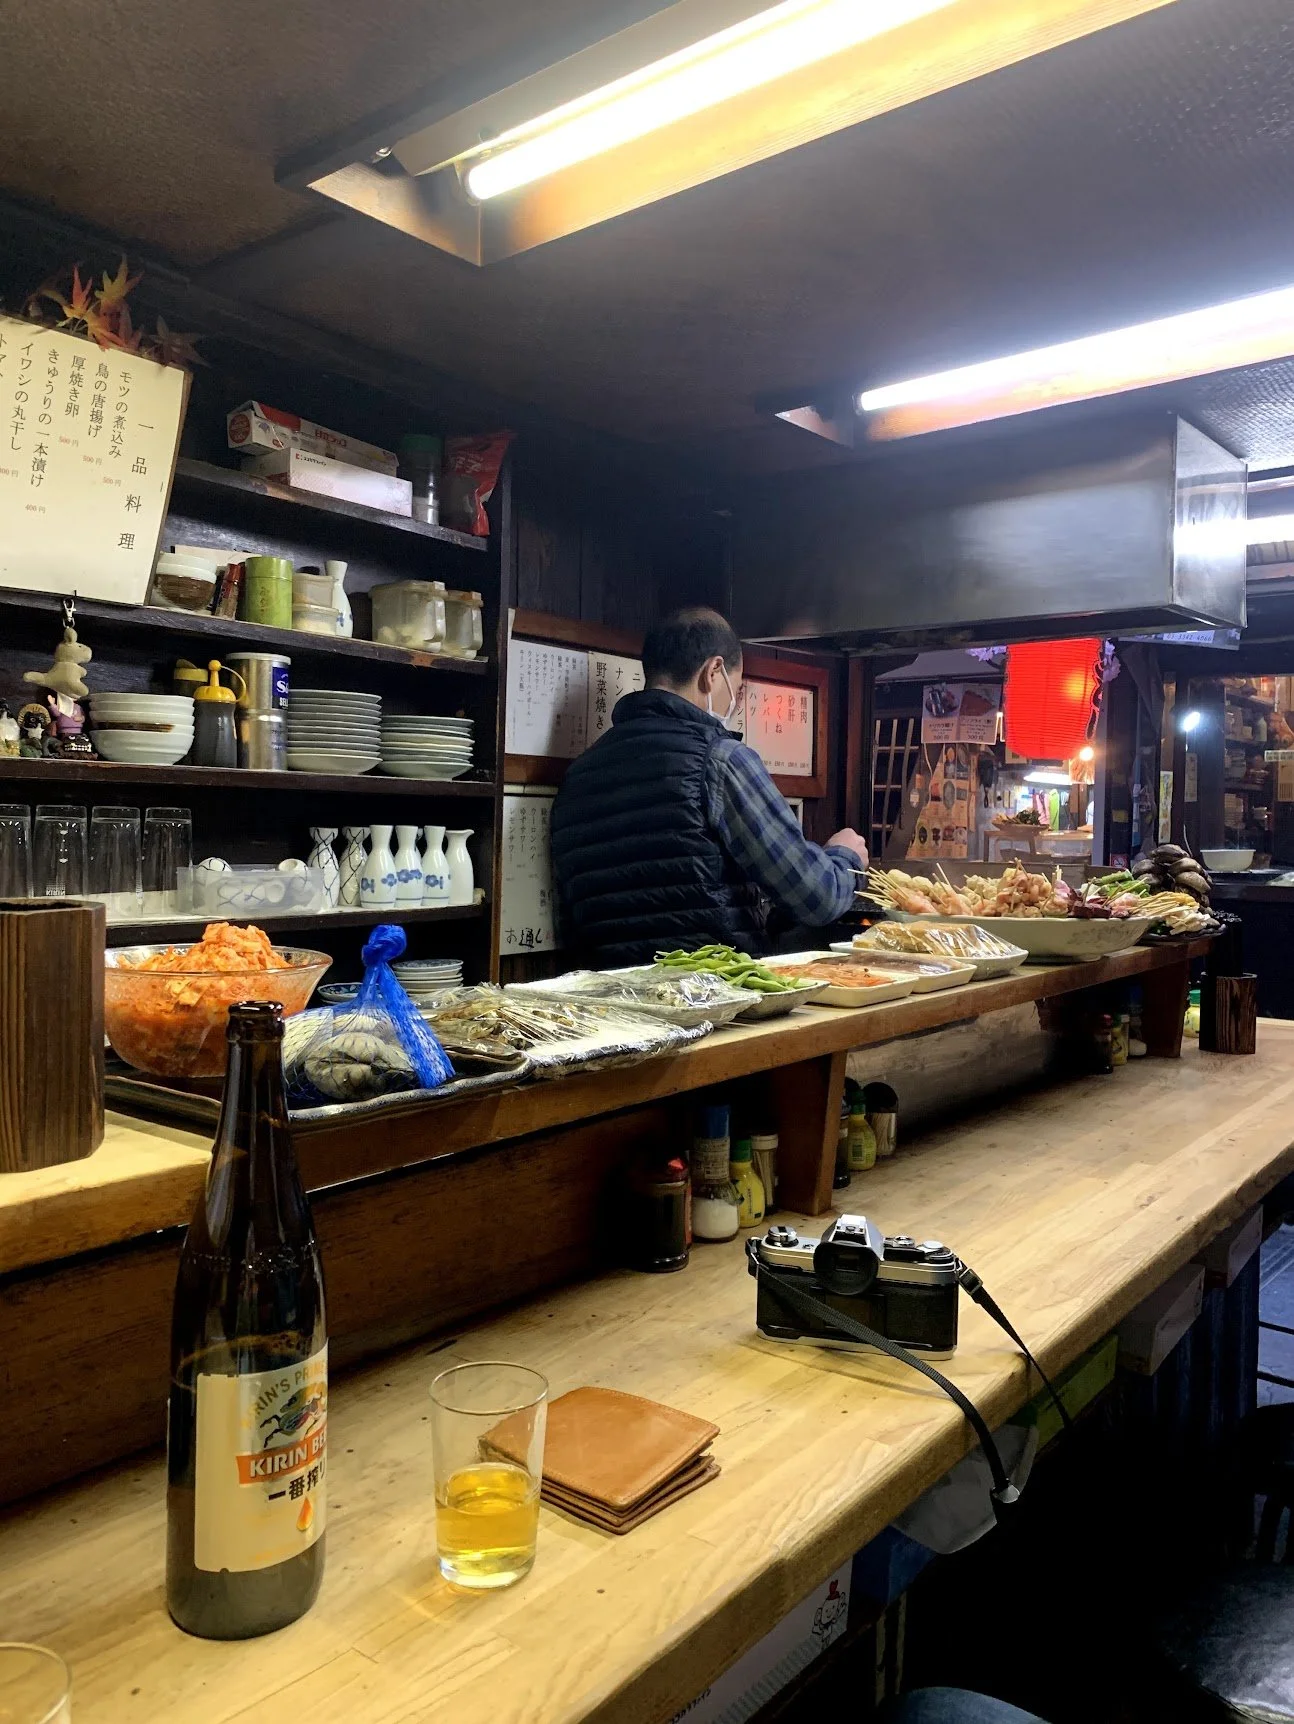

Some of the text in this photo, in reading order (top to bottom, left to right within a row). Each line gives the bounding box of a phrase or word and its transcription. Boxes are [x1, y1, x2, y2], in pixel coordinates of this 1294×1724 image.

[10, 343, 34, 450] イワシの丸干し
[30, 349, 59, 487] きゅうりの一本漬け
[64, 355, 86, 418] 厚焼き卵
[88, 363, 109, 438] 鳥の唐揚げ
[109, 371, 132, 458] モツの煮込み
[596, 661, 607, 729] 野菜焼き
[749, 693, 757, 716] ハツ
[775, 695, 783, 734] つくね
[788, 695, 795, 722] 砂肝
[250, 1443, 308, 1479] KIRIN
[268, 1456, 326, 1501] 一番搾り
